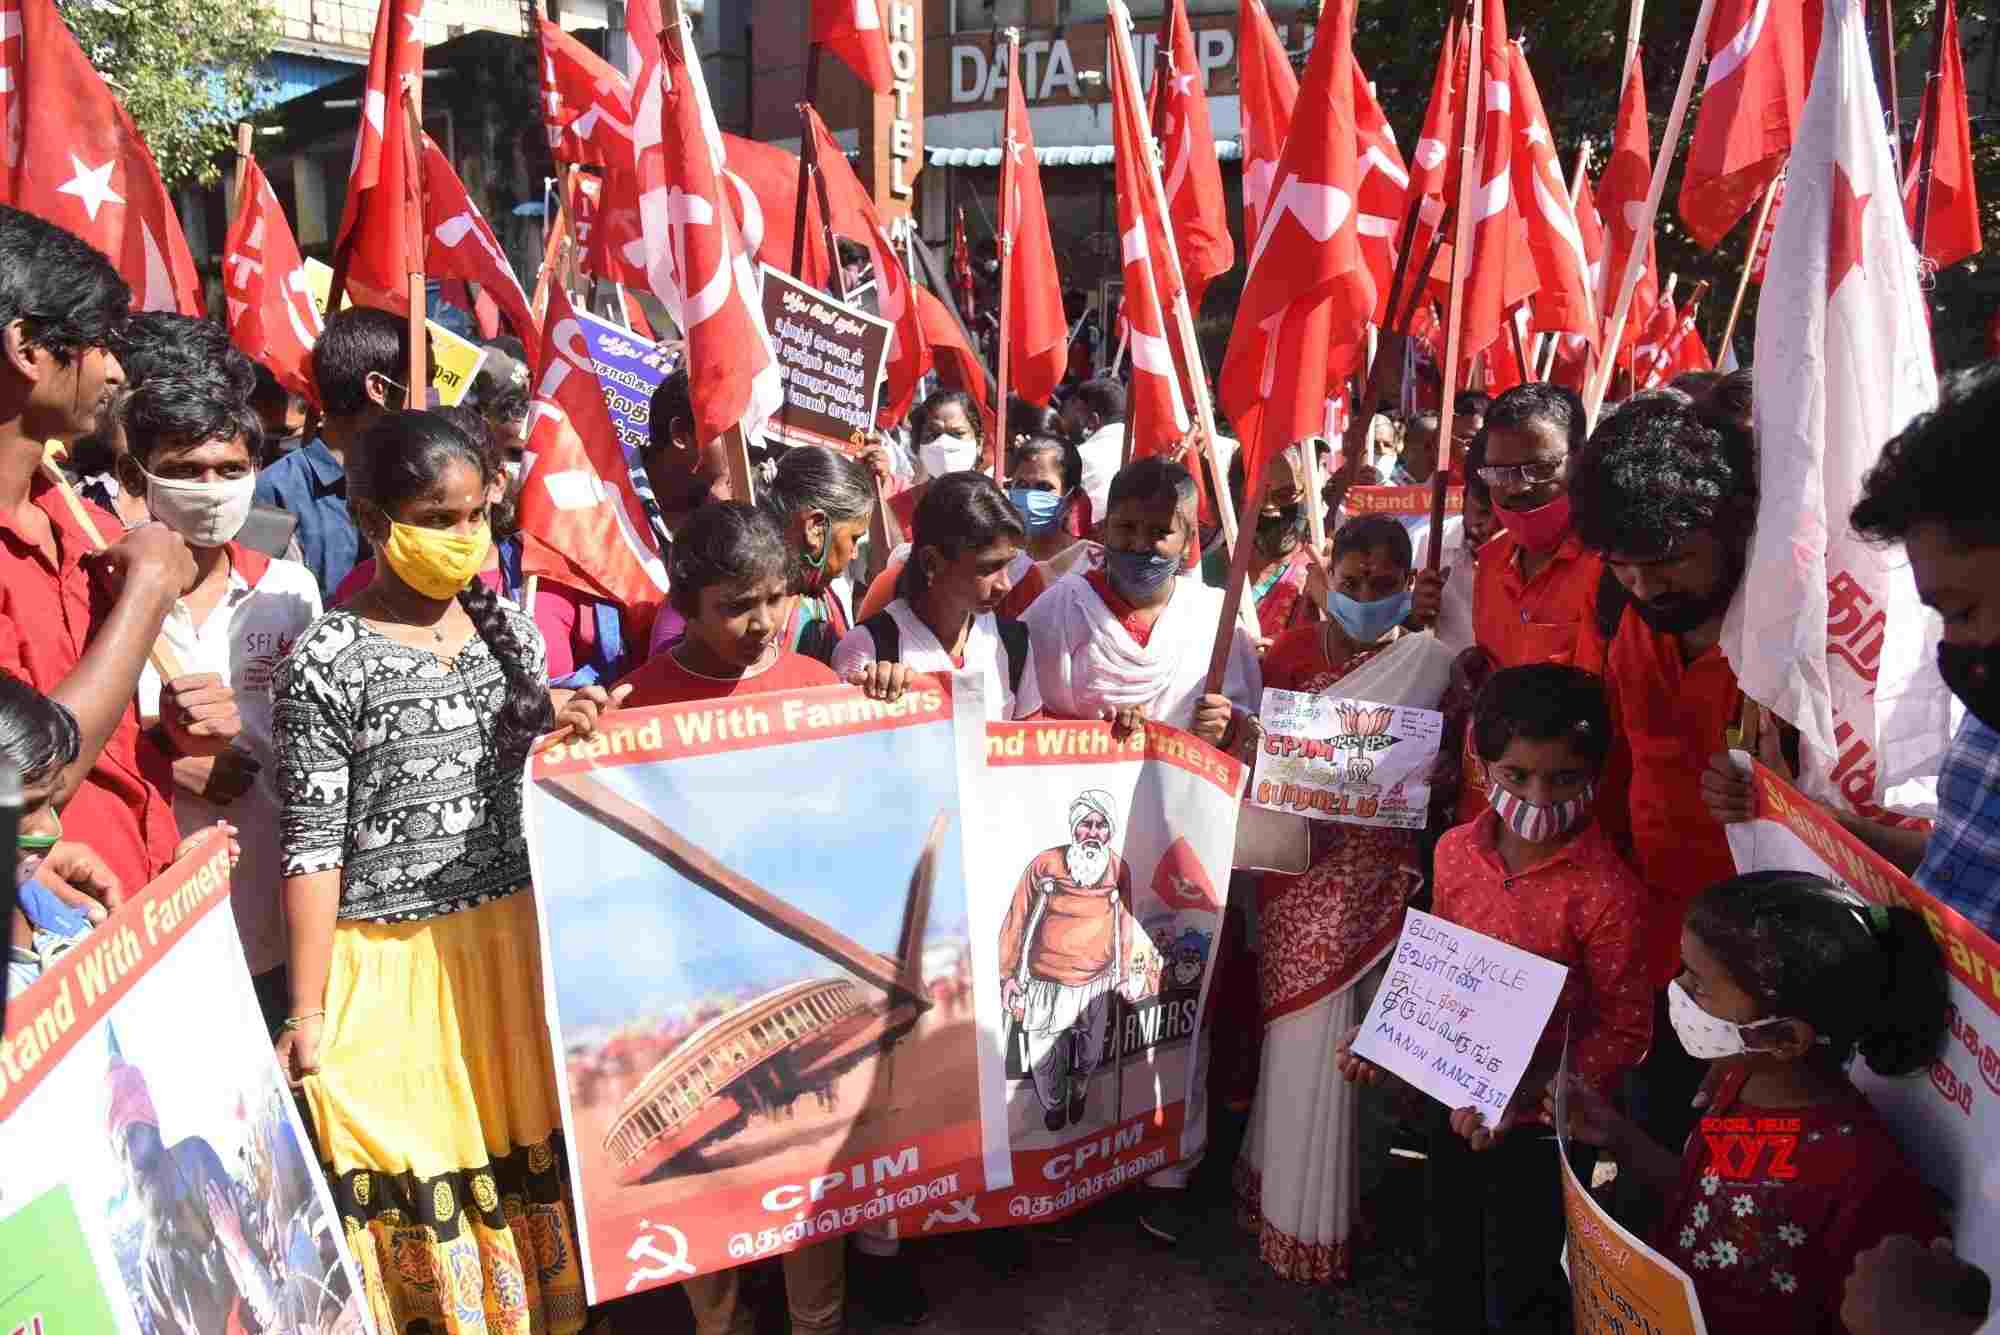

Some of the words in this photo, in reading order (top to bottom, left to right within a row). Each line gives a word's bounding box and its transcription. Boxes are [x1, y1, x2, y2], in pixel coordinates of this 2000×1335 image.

[891, 2, 917, 198] HOTEL
[1352, 490, 1415, 510] Stand
[673, 702, 770, 746] With
[780, 686, 942, 733] Farmers
[1035, 728, 1109, 756] With
[75, 924, 142, 1008] With
[142, 849, 231, 946] Farmers
[1463, 949, 1528, 991] UNCLE
[761, 1145, 919, 1212] CPIM
[1041, 1124, 1146, 1182] CPIM
